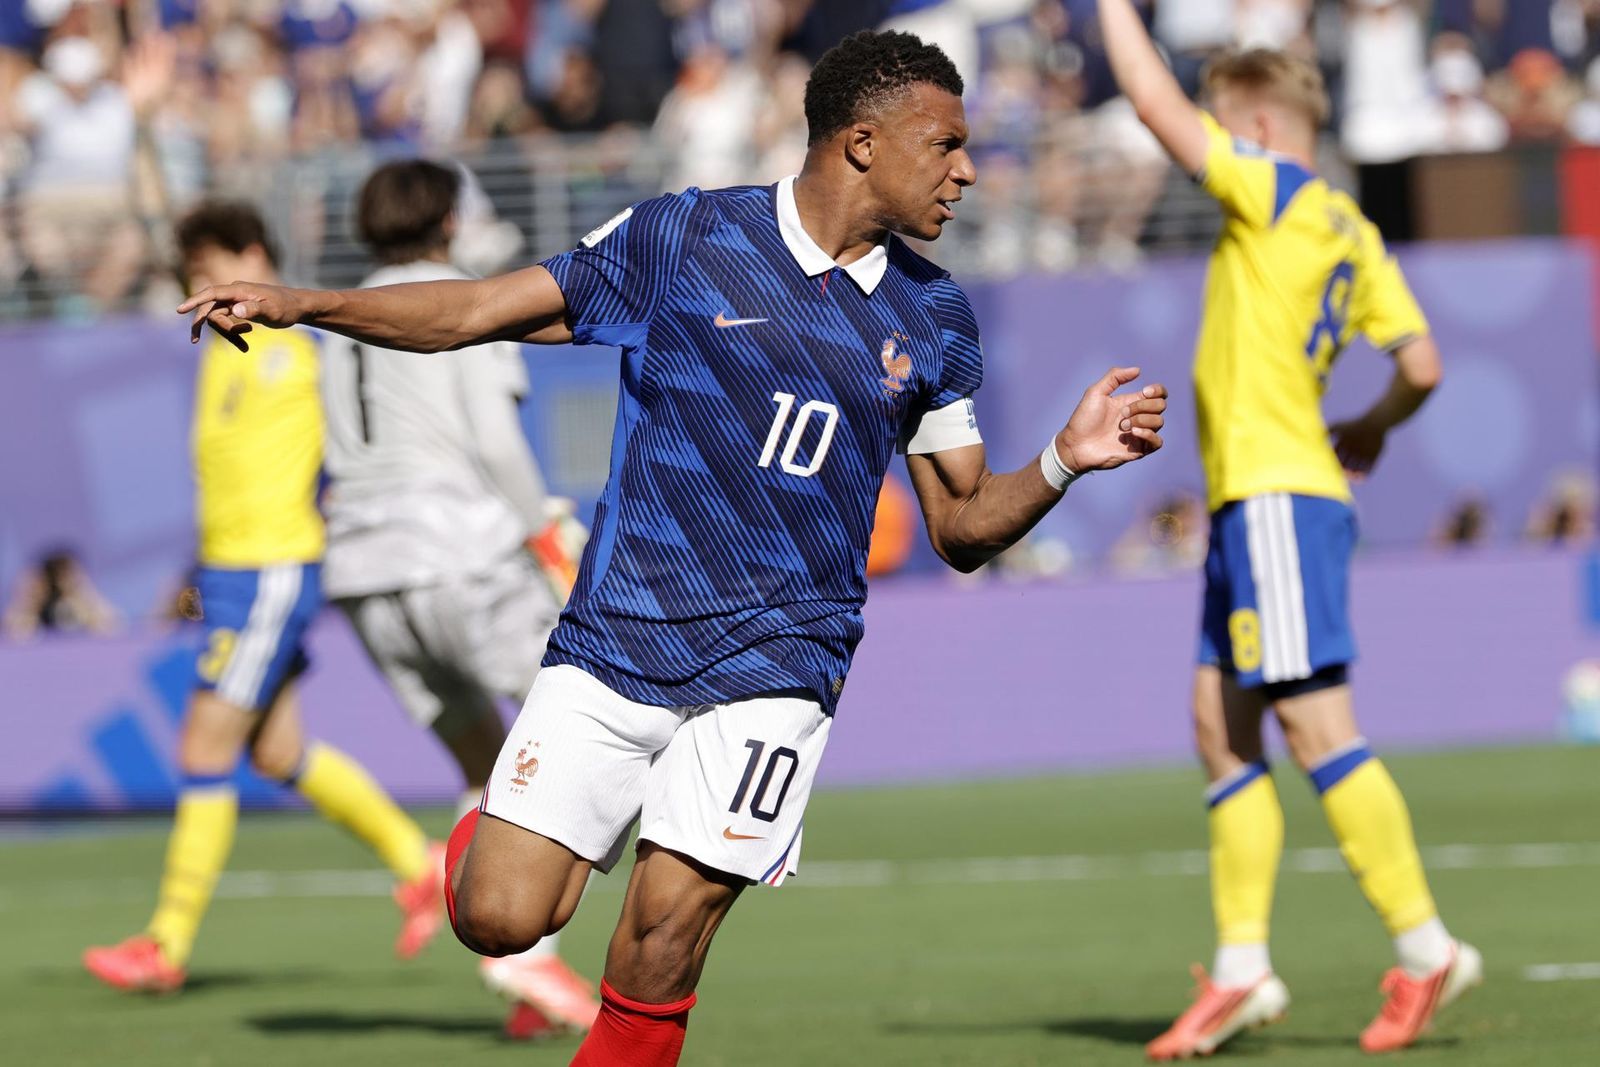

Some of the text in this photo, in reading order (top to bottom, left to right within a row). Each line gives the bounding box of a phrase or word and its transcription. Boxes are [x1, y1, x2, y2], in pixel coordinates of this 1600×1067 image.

[757, 391, 839, 477] 10
[1228, 607, 1263, 672] 8
[728, 738, 799, 823] 10
